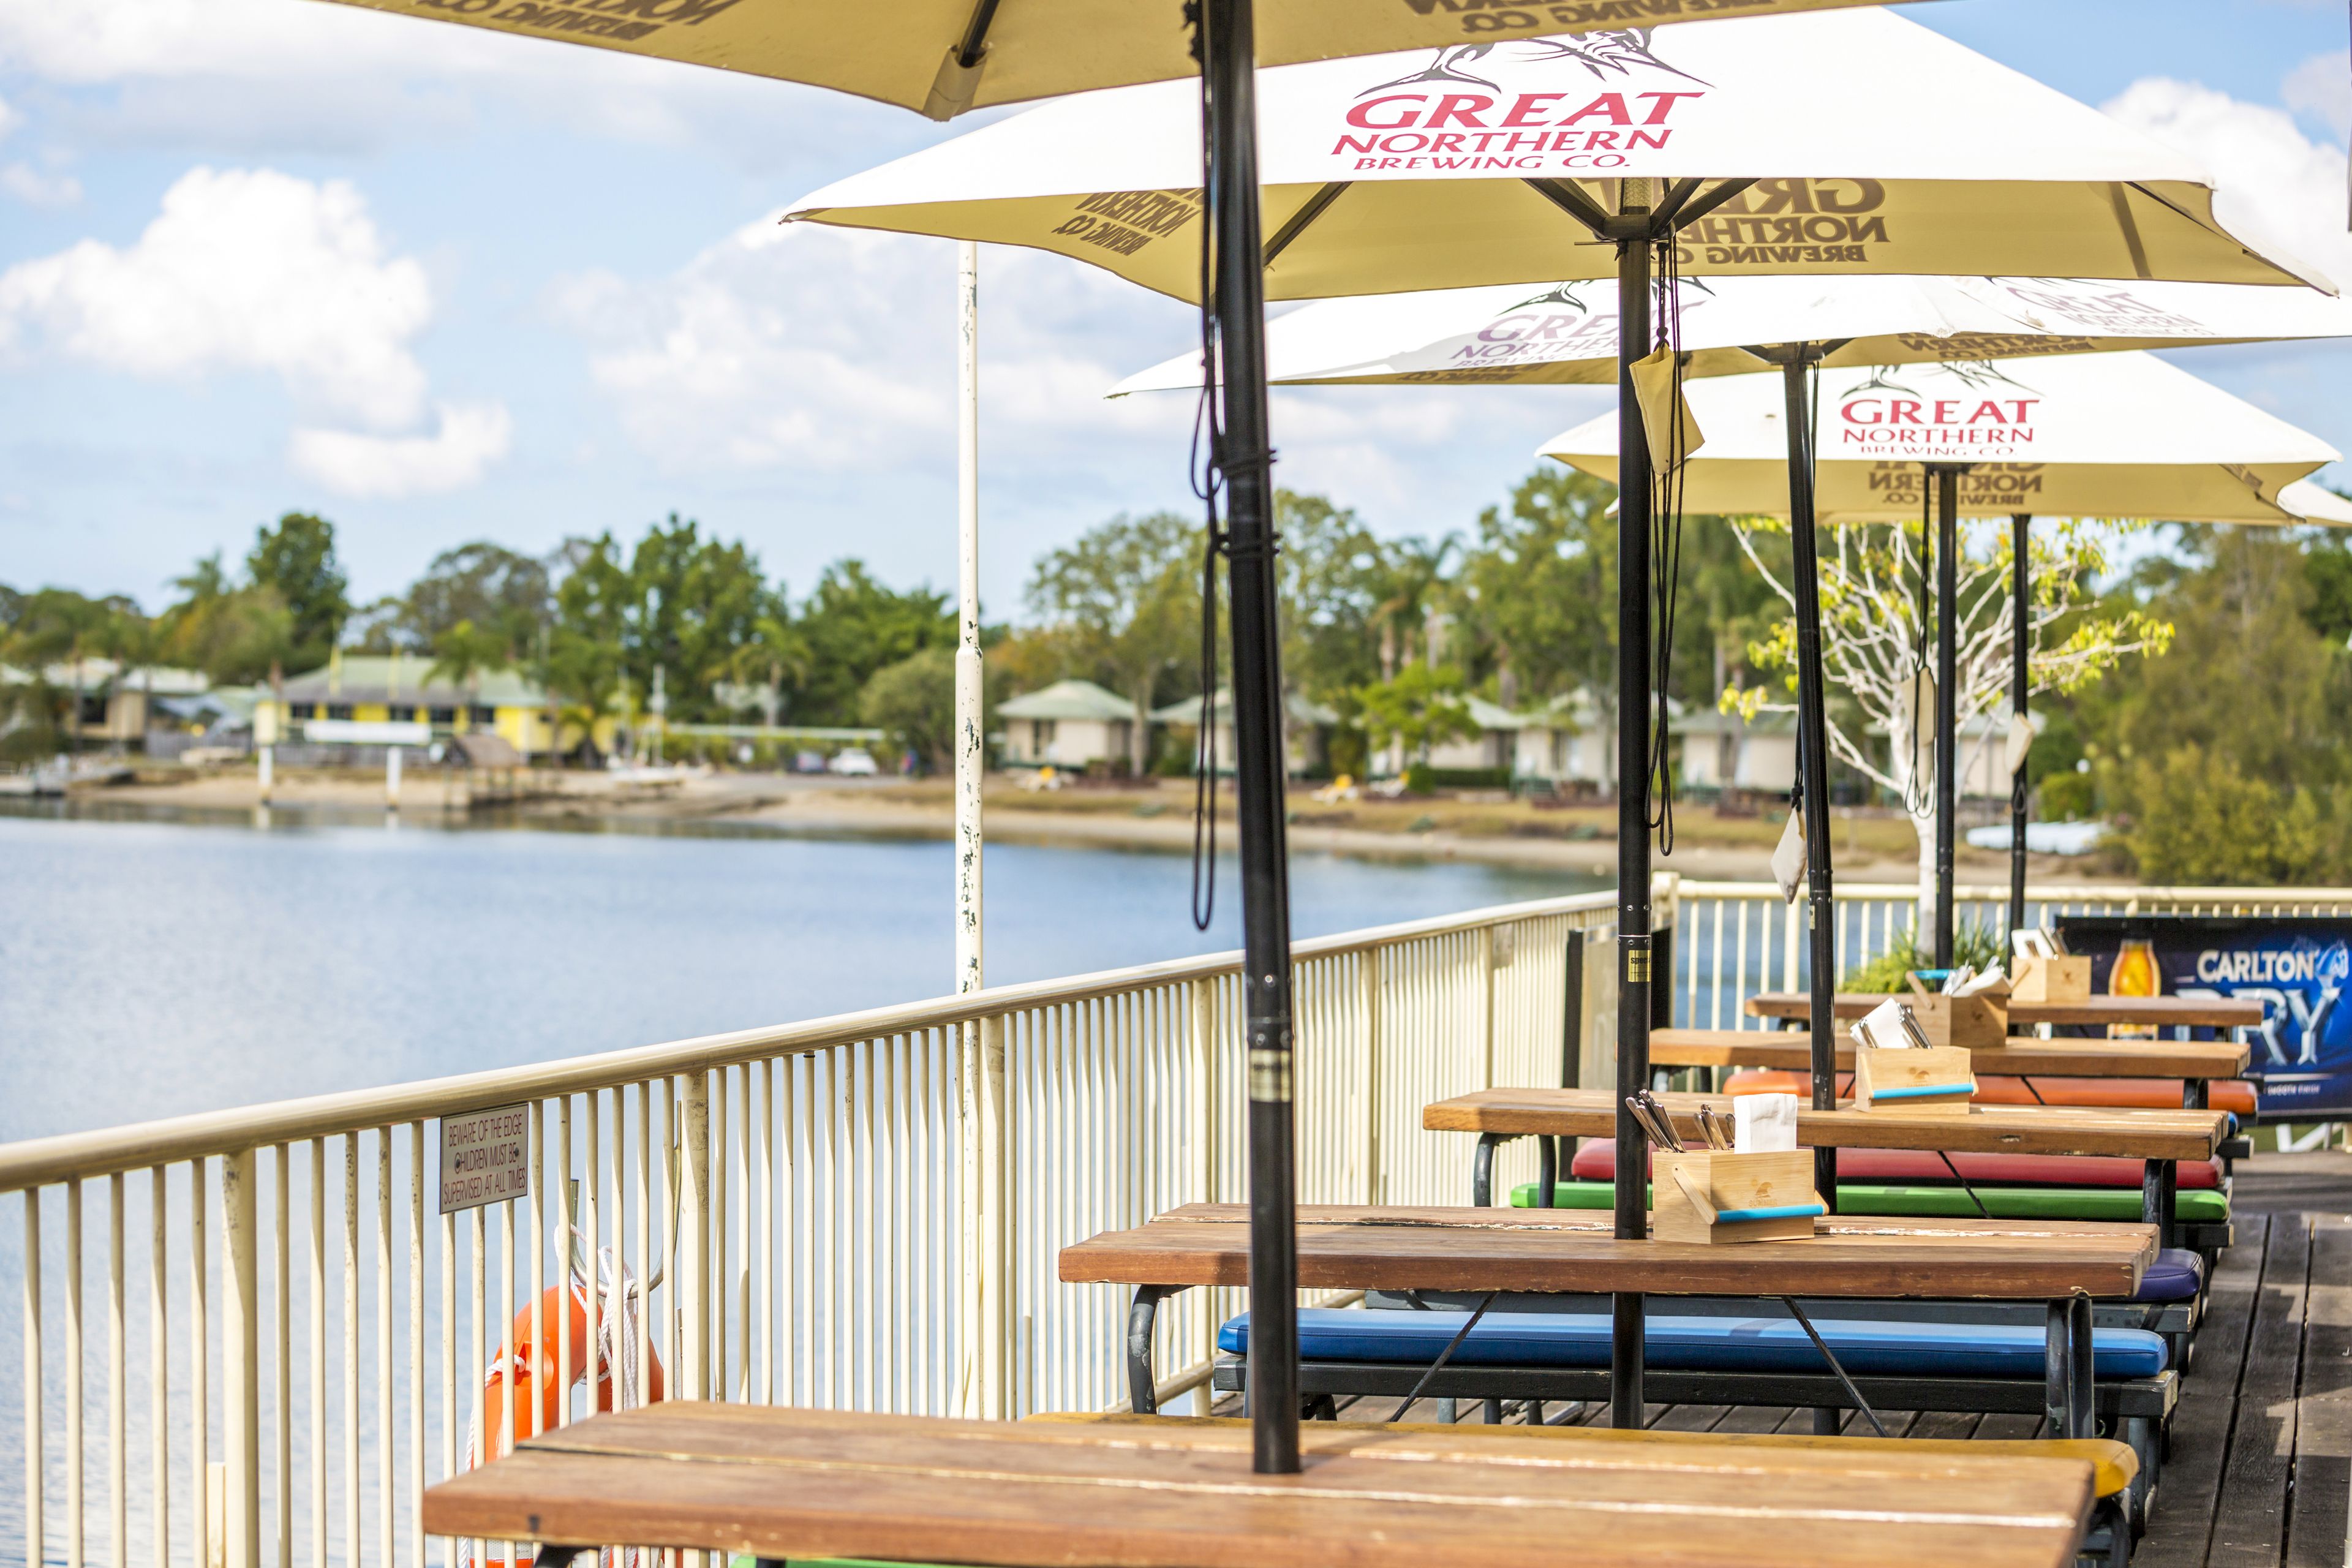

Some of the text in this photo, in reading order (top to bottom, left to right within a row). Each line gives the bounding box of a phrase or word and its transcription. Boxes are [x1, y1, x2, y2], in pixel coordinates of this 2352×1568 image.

[1346, 92, 1705, 129] GREAT
[1331, 129, 1673, 155] NORTHERN
[1354, 154, 1630, 170] BREWING CO.
[1841, 399, 2040, 424] GREAT
[1843, 428, 2034, 444] NORTHERN
[1861, 445, 2018, 457] BREWING CO.
[2197, 950, 2315, 982] CARLTON
[449, 1114, 522, 1147] BEWARE OF THE EDGE
[454, 1142, 517, 1174] CHILDREN MUST BE
[444, 1167, 526, 1204] SUPERVISED AT ALL TIMES
